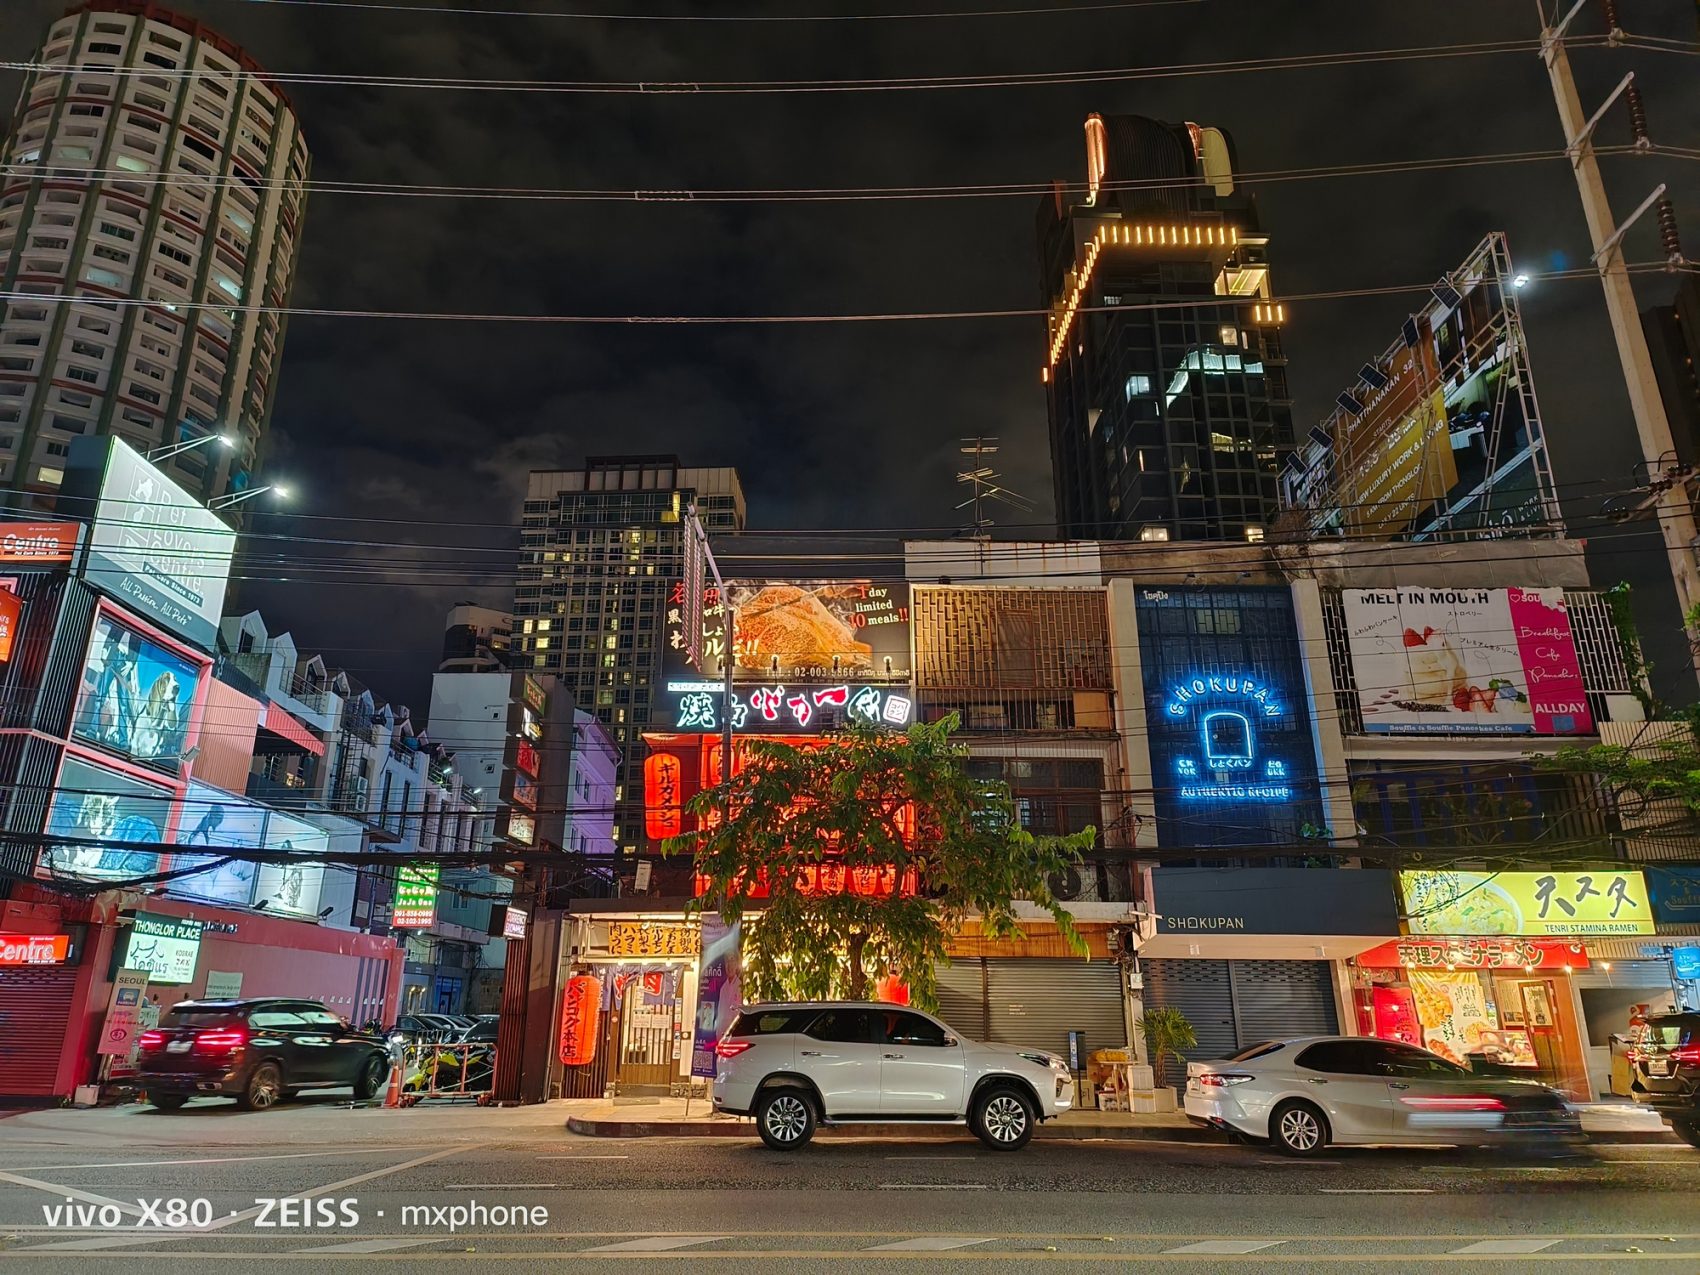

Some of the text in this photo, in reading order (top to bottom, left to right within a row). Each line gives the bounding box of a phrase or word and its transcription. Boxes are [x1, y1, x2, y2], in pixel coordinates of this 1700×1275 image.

[1369, 466, 1392, 493] LUXURY
[1392, 447, 1414, 470] WORK
[868, 587, 888, 598] day
[1361, 592, 1404, 605] MELT
[1409, 592, 1425, 605] IN
[855, 599, 894, 613] limited
[1169, 677, 1281, 717] SHOKUPAN
[1535, 703, 1586, 714] ALLDAY
[134, 920, 175, 937] THONGLOR
[176, 925, 201, 940] PLACE
[1544, 924, 1638, 933] TENRI STAMINA RAMEN
[118, 976, 147, 986] SEOUL
[561, 981, 586, 1057] バンコク本店
